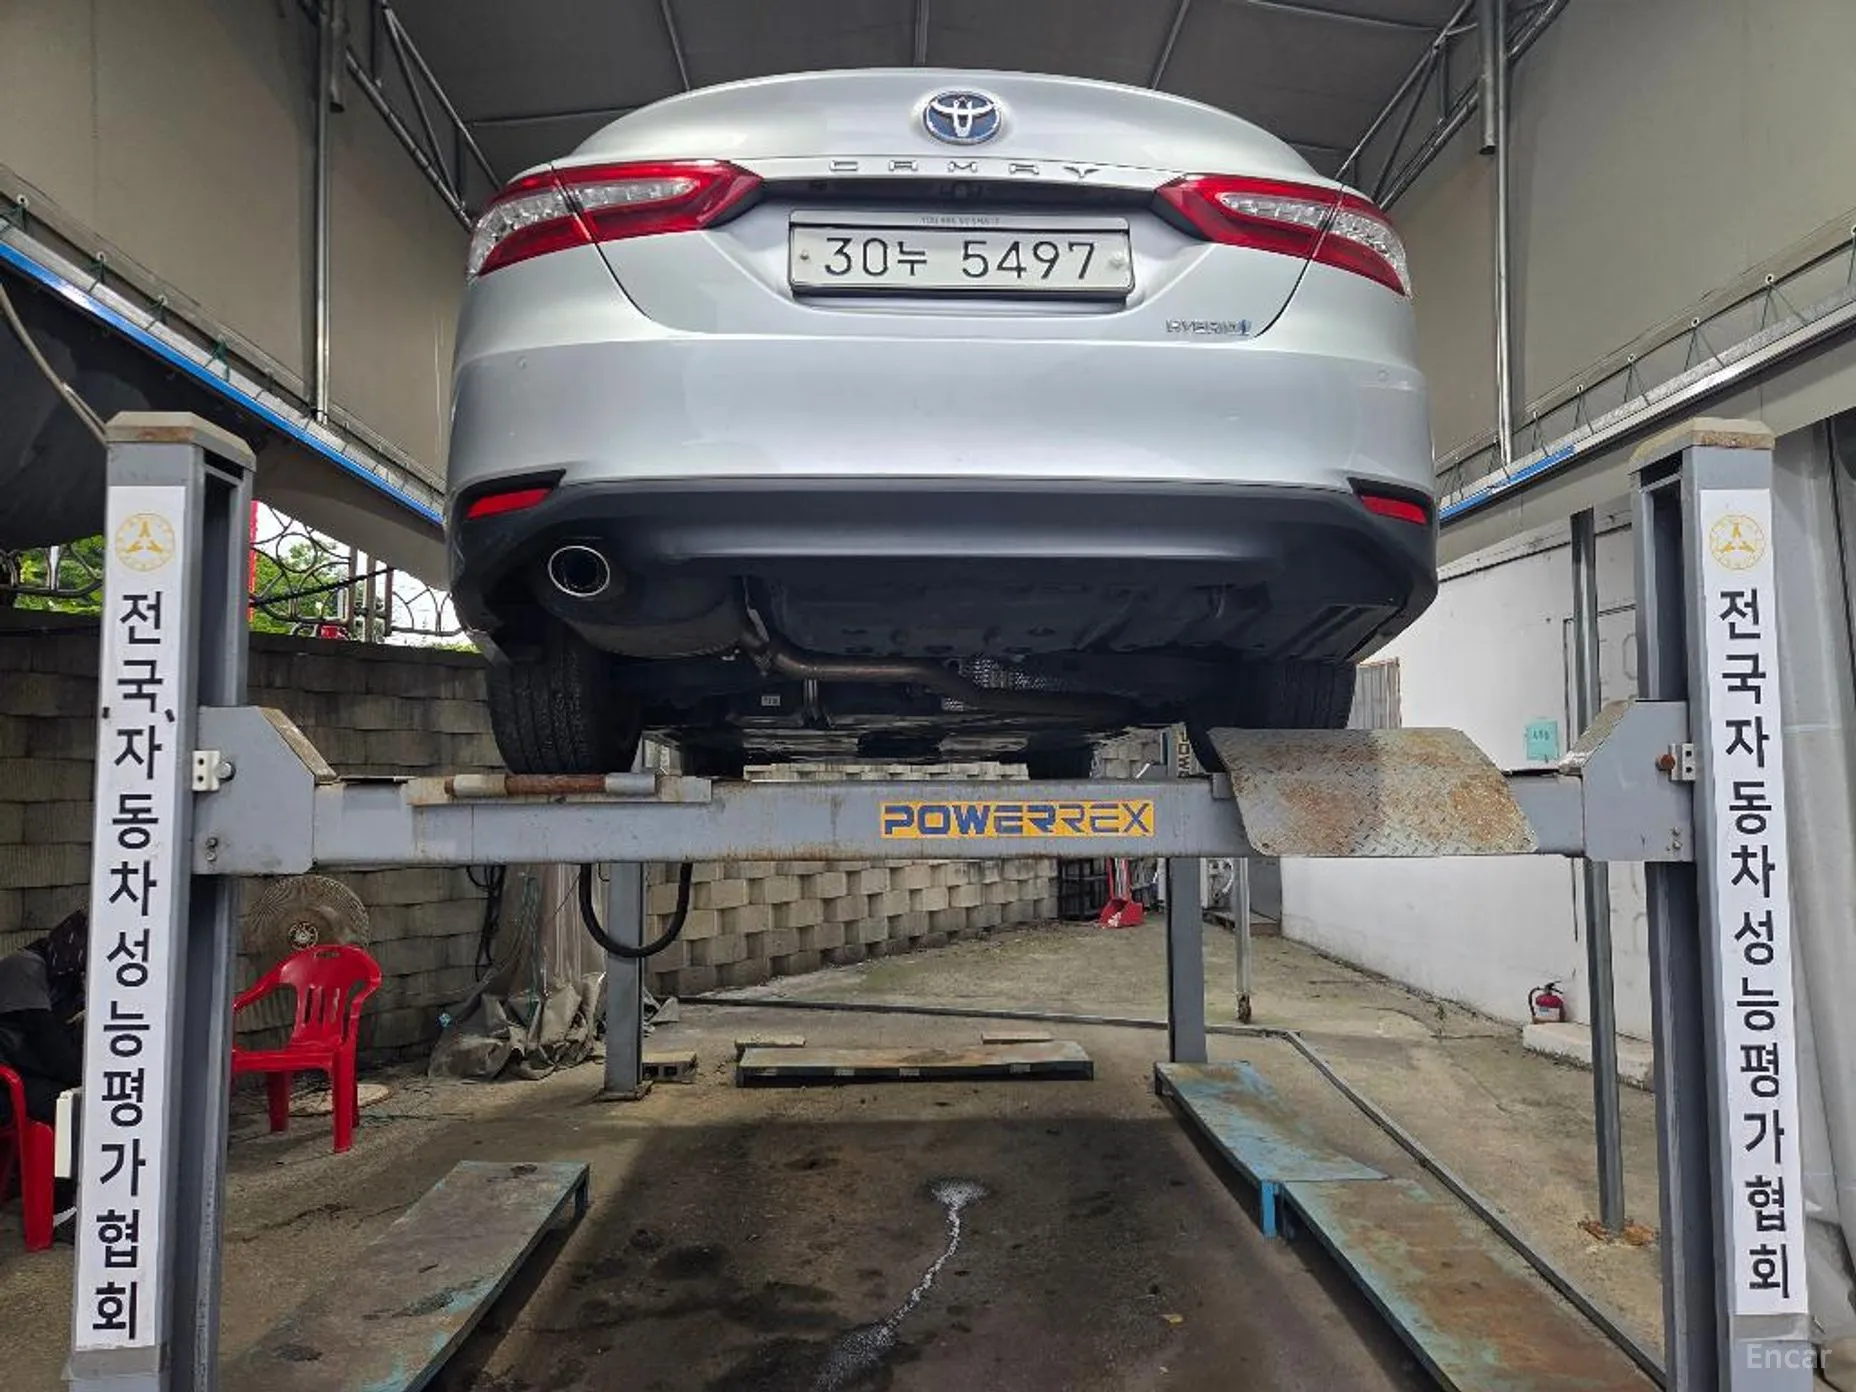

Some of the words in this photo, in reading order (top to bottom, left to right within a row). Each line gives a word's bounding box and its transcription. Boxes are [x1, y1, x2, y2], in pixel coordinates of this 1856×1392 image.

[829, 159, 1098, 178] CAMRY
[824, 237, 928, 277] 30누
[961, 240, 1096, 280] 5497
[883, 802, 1151, 835] POWERREX
[1719, 587, 1790, 1299] 전국자동차성능평가협회
[92, 590, 163, 1340] 전국자동차성능평가협회
